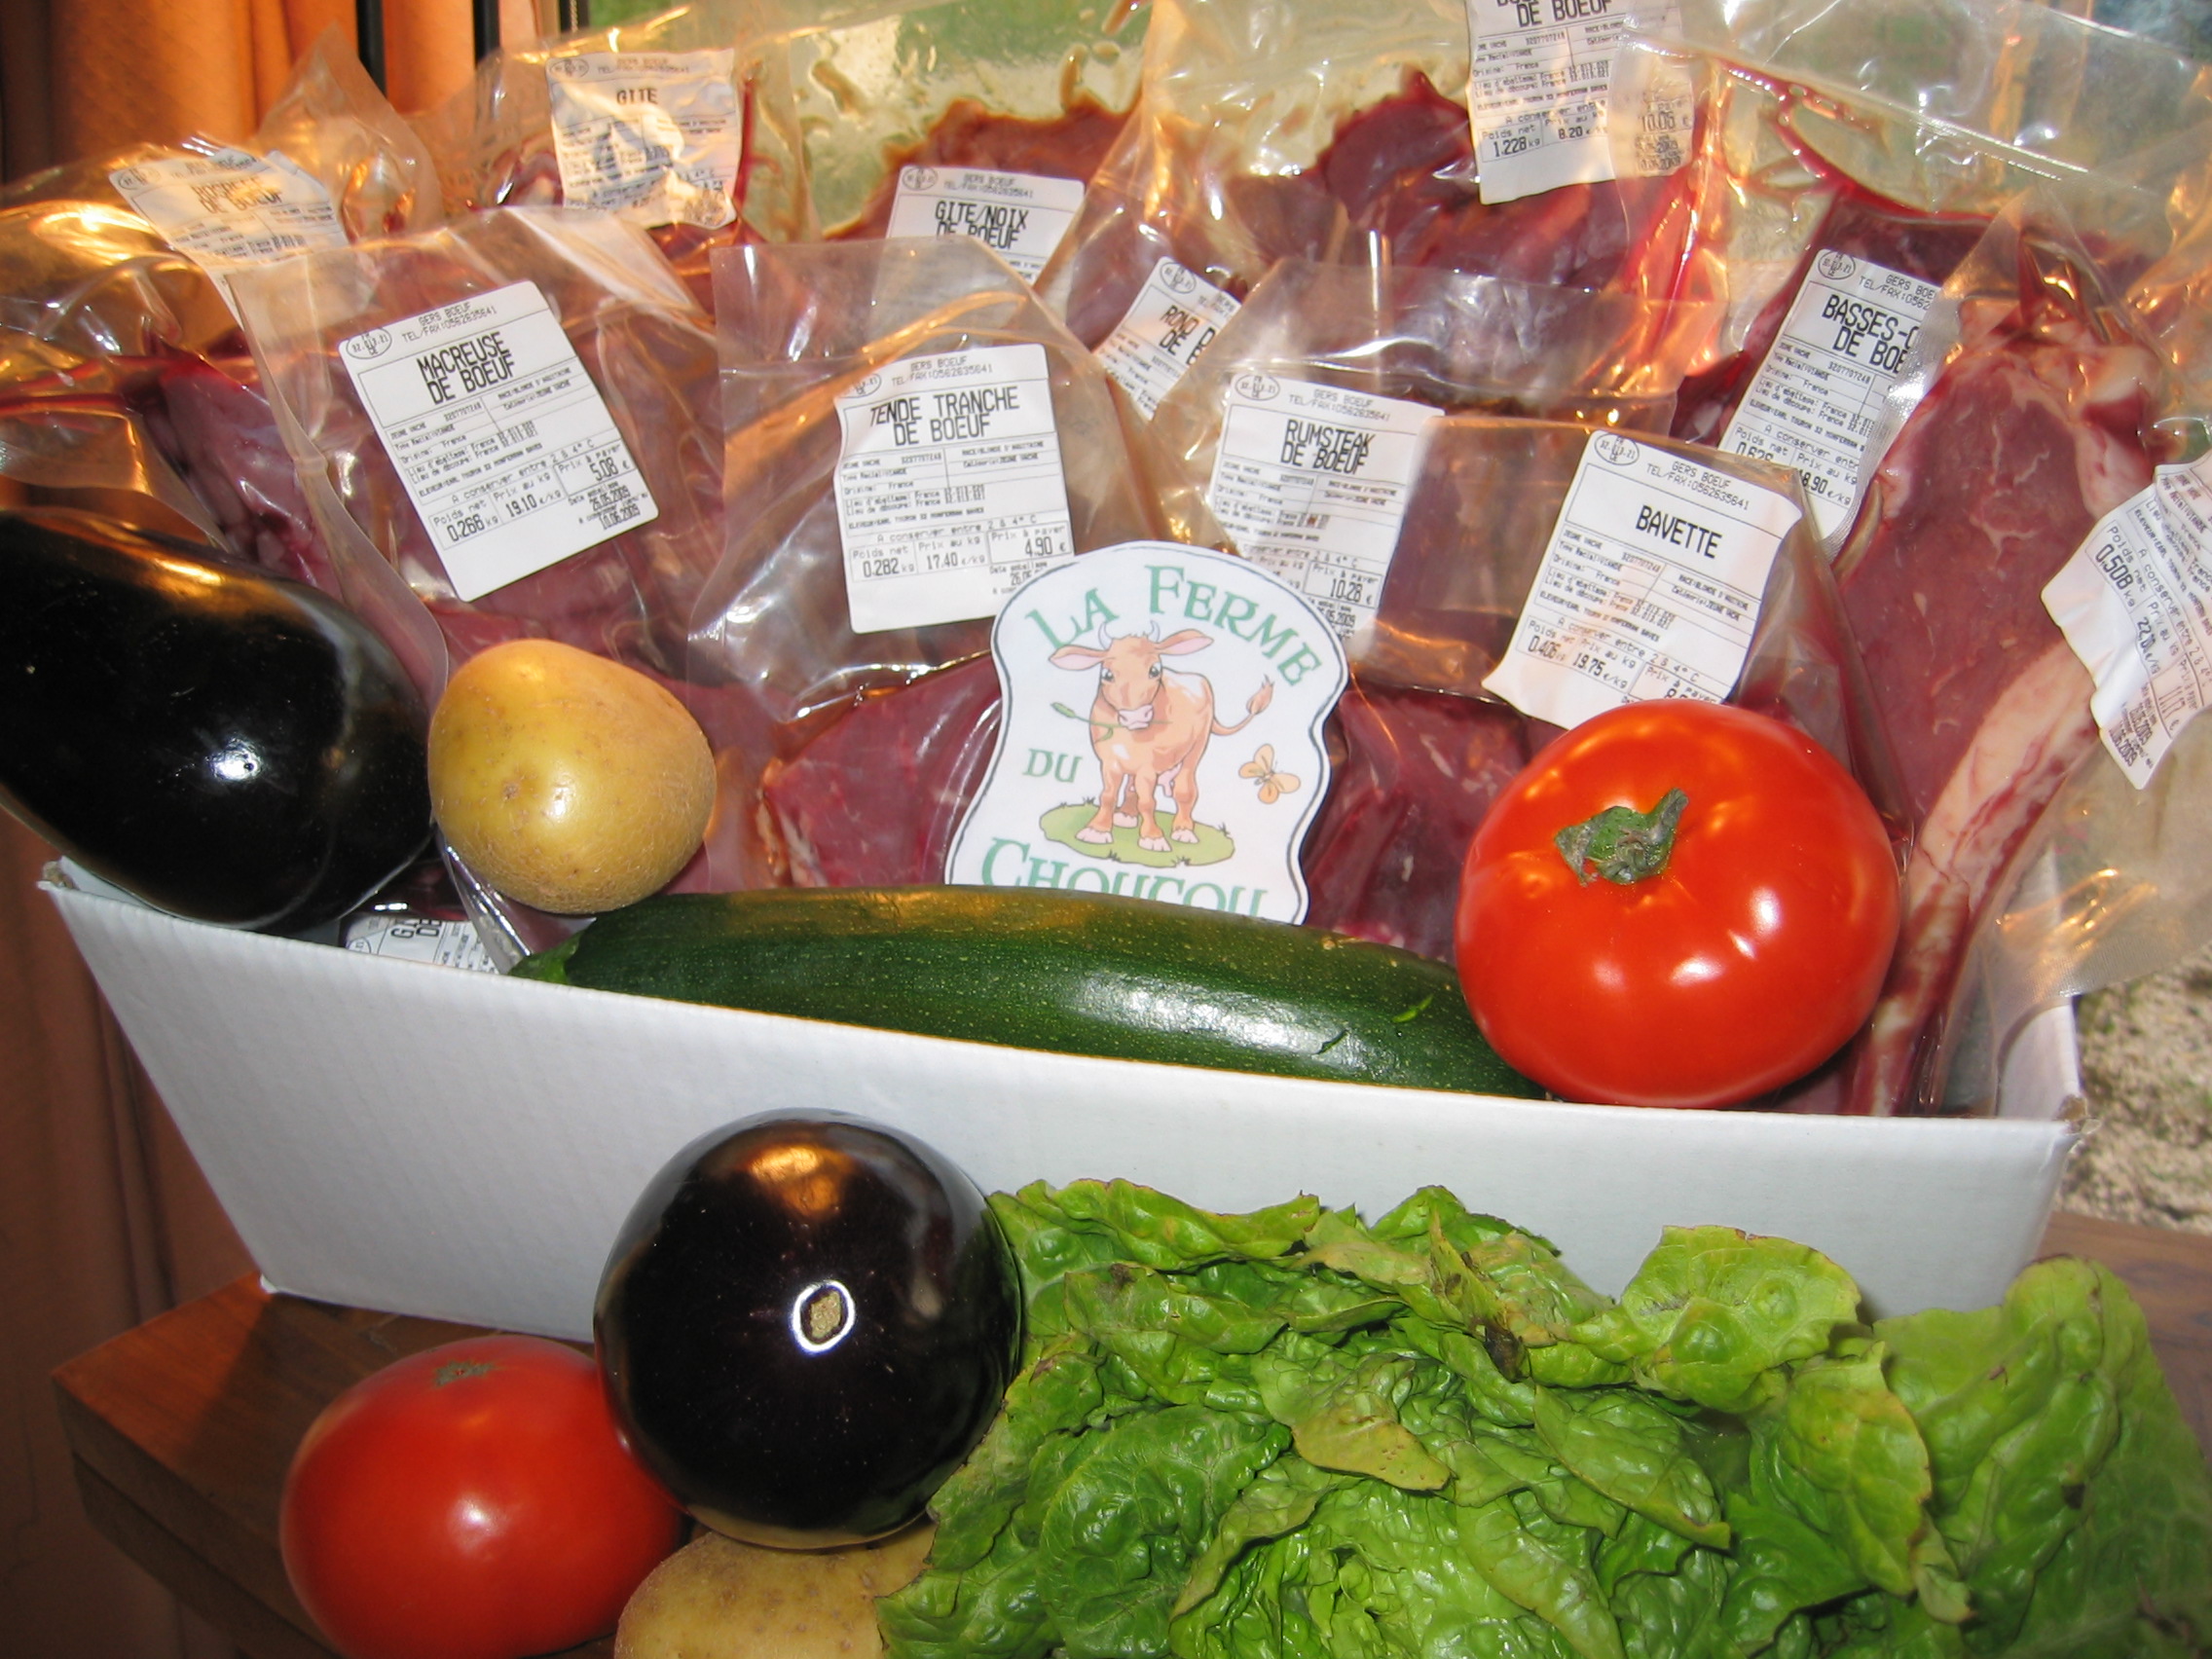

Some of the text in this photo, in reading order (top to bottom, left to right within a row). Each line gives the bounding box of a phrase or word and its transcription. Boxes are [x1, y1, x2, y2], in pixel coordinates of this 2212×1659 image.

[1517, 1, 1543, 27] DE
[616, 88, 659, 104] GITE
[935, 200, 1030, 230] GITE/NOIX
[1859, 276, 1931, 311] TEL/FAX:0562
[1885, 274, 1936, 300] GERS BOE
[419, 302, 472, 328] GERS BOEUF
[1160, 305, 1199, 337] ROND
[1821, 294, 1920, 350] BASSES-C
[1159, 329, 1188, 356] DE
[1832, 325, 1865, 357] DE
[1869, 341, 1908, 374] BOE
[416, 331, 510, 384] MACREUSE
[938, 355, 969, 367] BOEUF
[426, 352, 515, 405] DE BOEUF
[869, 386, 1020, 427] TENDE TRANCHE
[1313, 388, 1375, 408] GERS BOEUF
[893, 412, 991, 447] DE BOEUF
[1285, 418, 1376, 458] RUMSTEAK
[1735, 426, 1788, 457] Poids net
[1776, 430, 1830, 458] conserver
[558, 460, 582, 474] Prix
[589, 457, 619, 482] 5.08
[1280, 441, 1366, 475] DE BOEUF
[1796, 453, 1859, 485] Prix au kg
[463, 473, 513, 499] conserver
[518, 460, 547, 477] entre
[493, 471, 551, 501] Prix au kg
[1645, 462, 1751, 511] TEL/FAX:0562635641
[1672, 461, 1732, 489] GERS BOEUF
[433, 499, 487, 527] Poids net
[505, 494, 538, 518] 19.10
[486, 515, 499, 527] kg
[890, 528, 944, 541] conserver
[951, 523, 981, 535] entre
[1635, 504, 1723, 559] BAVETTE
[918, 535, 980, 551] Prix au kg
[991, 531, 1016, 541] Prix
[1025, 535, 1052, 557] 4.90
[852, 544, 908, 560] Poids net
[926, 551, 959, 571] 17.40
[2106, 526, 2147, 593] Poids net
[863, 557, 915, 578] 0.282 kg
[1312, 563, 1335, 576] Prix
[2095, 543, 2136, 608] 0.508 kg
[1330, 577, 1363, 603] 10.28
[2144, 564, 2181, 616] conserver
[1024, 563, 1323, 688] LA FERME
[1528, 619, 1558, 639] Poids
[1604, 650, 1618, 661] au
[1621, 655, 1637, 669] kg
[1614, 639, 1645, 658] entre
[1572, 651, 1606, 677] 19.75
[1644, 666, 1670, 682] Prix
[1021, 747, 1083, 785] DU
